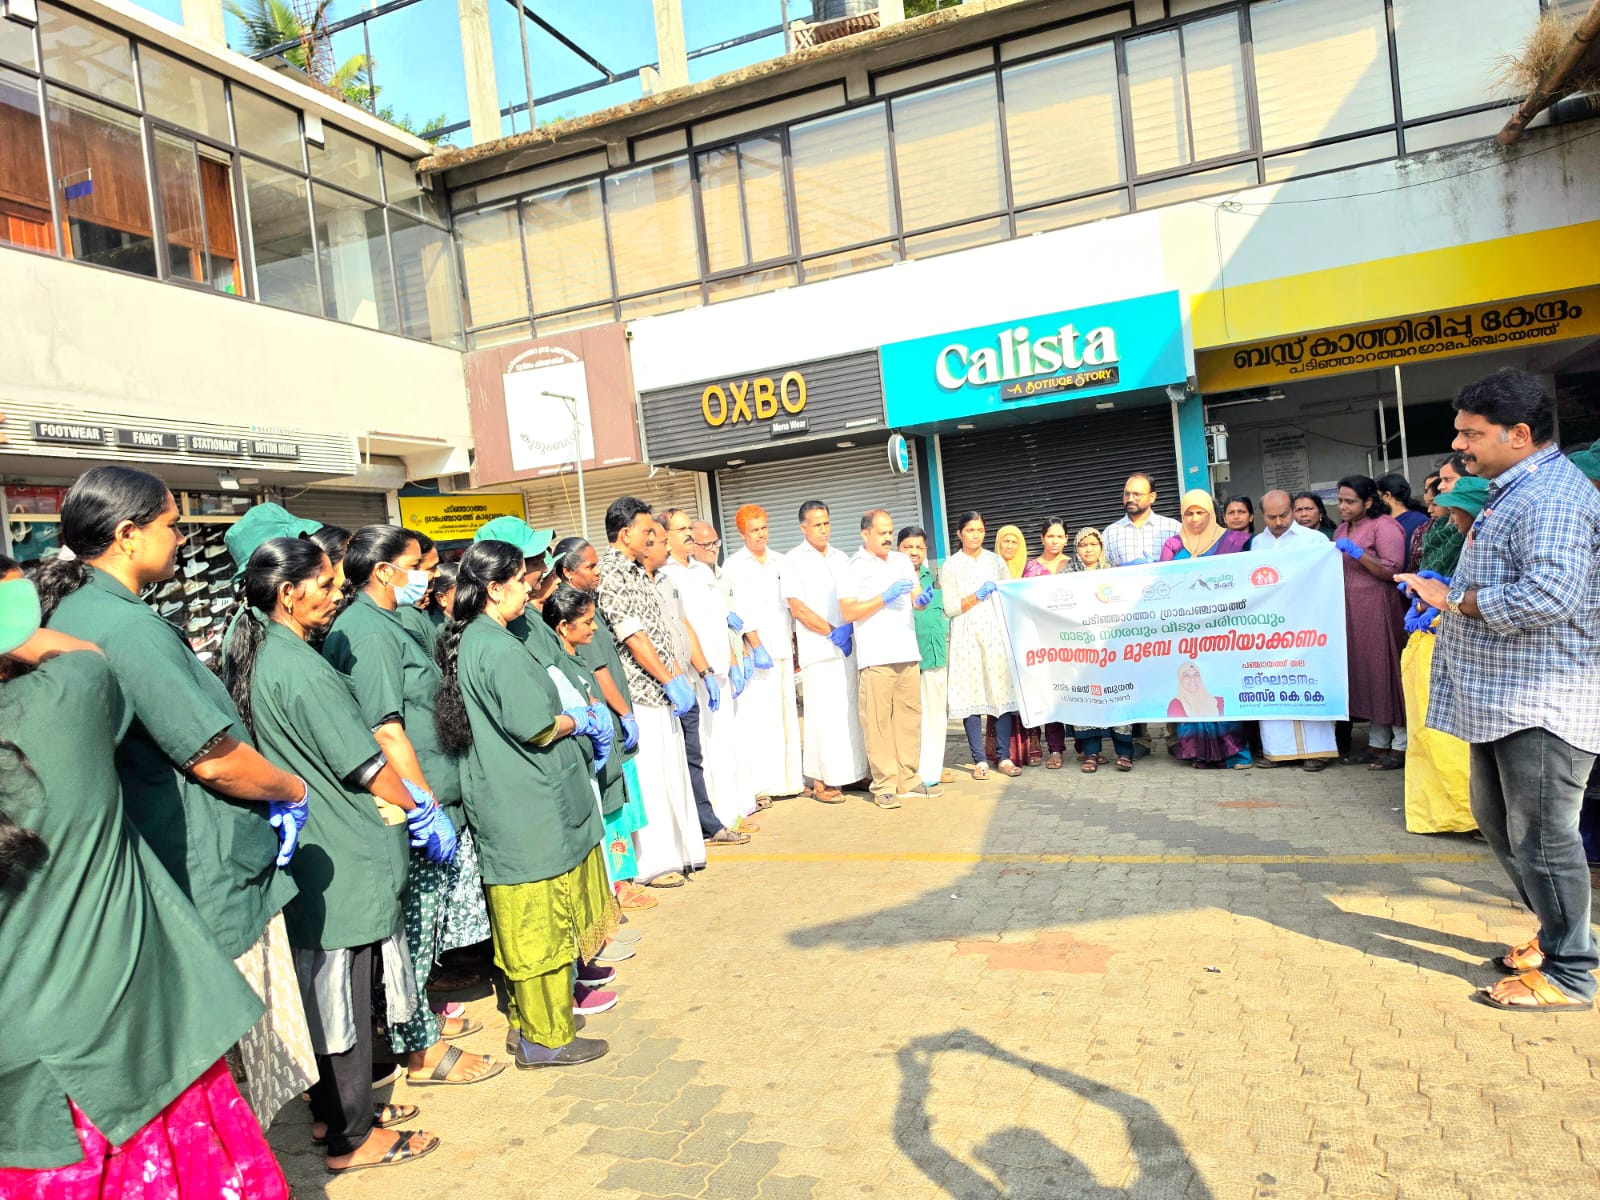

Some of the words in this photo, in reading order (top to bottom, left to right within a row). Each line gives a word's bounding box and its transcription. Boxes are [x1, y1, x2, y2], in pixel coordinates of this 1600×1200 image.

[1481, 300, 1582, 332] കേന്ദ്രം
[935, 323, 1120, 390] Calista
[1075, 369, 1112, 387] STORY
[702, 370, 807, 427] OXBO
[40, 423, 100, 439] FOOTWEAR
[772, 422, 790, 432] Mens
[790, 420, 806, 430] Wear
[132, 431, 163, 446] FANCY
[192, 437, 239, 452] STATIONARY
[1082, 610, 1156, 625] പടിഞ്ഞാറത്തറ
[1160, 599, 1247, 621] ഗ്രാമപഞ്ചായത്ത്
[1060, 631, 1096, 644] നാടും
[1100, 625, 1158, 640] നഗരവും
[1161, 622, 1201, 634] വീടും
[1205, 613, 1286, 628] പരിസരവും
[1026, 647, 1117, 668] മഴയെത്തും
[1178, 629, 1328, 660] വൃത്തിയാക്കണം
[1239, 689, 1275, 702] അസ്മ
[1280, 690, 1300, 702] കെ
[1304, 690, 1325, 702] കെ
